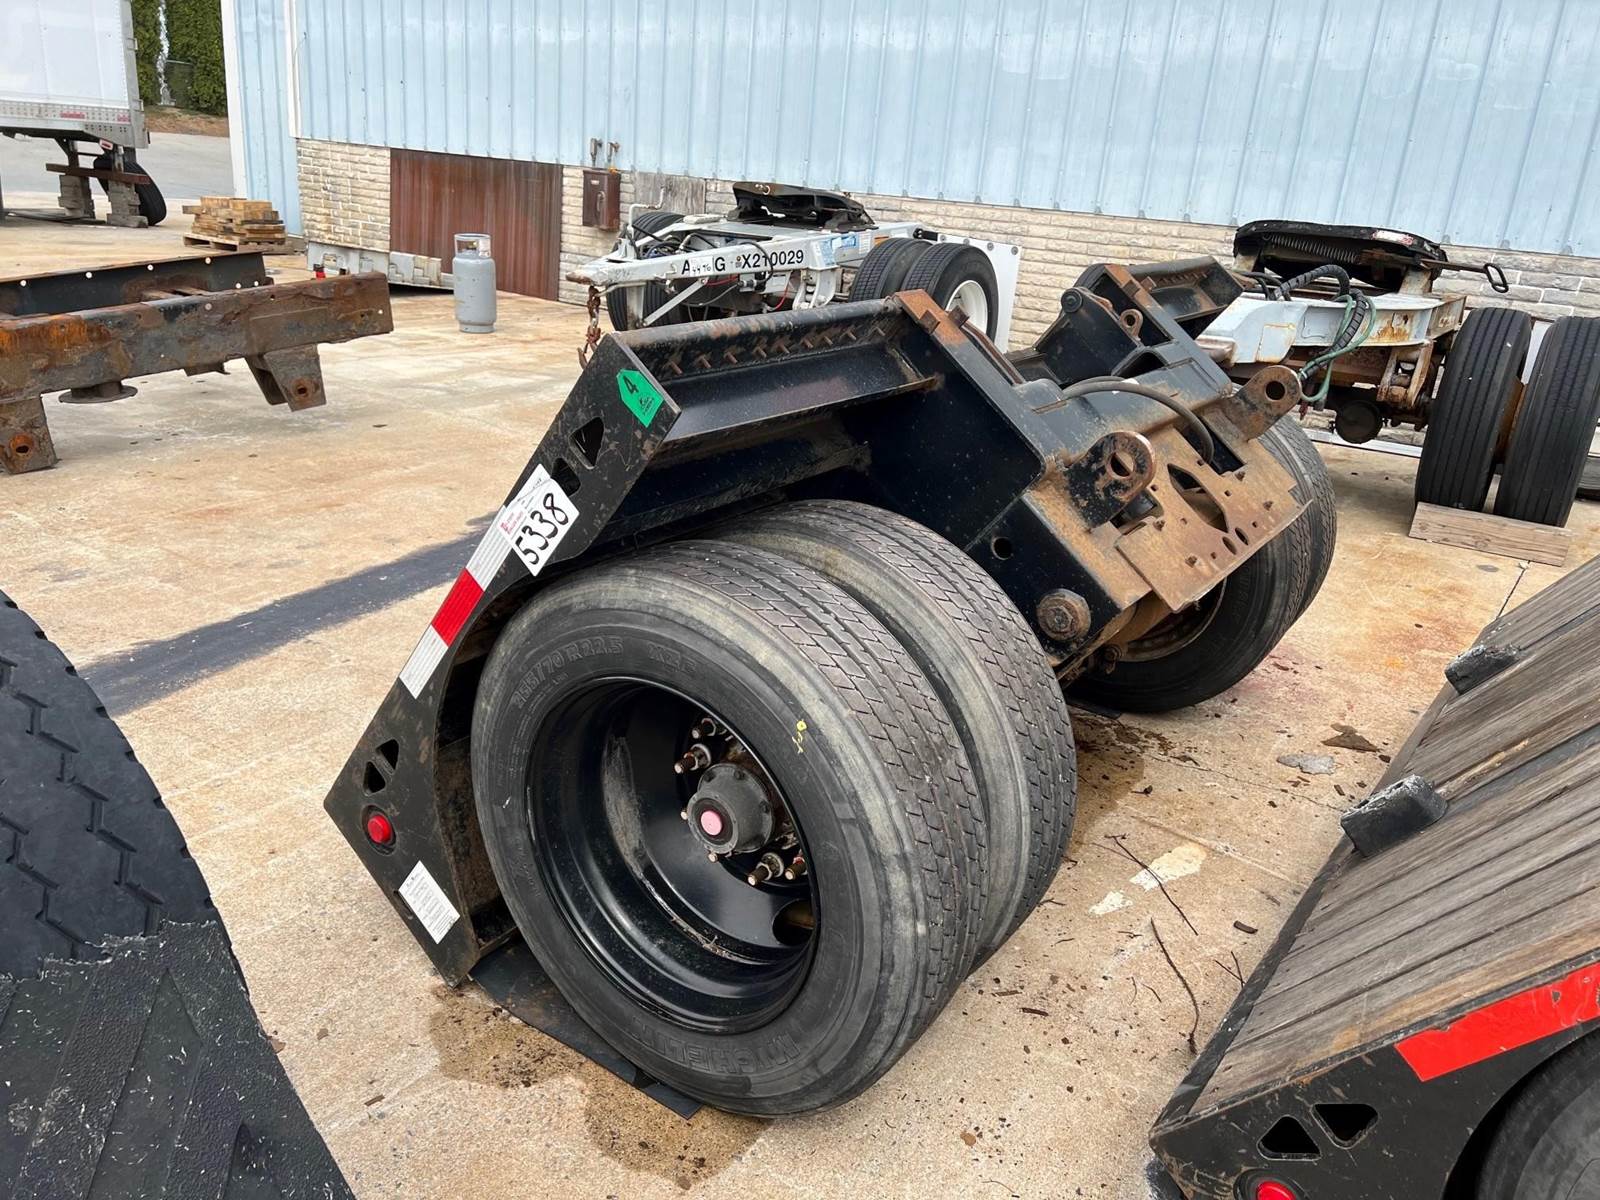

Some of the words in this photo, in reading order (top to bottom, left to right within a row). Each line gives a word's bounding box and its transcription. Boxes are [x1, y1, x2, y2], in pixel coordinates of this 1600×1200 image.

[741, 249, 804, 269] X210029
[622, 375, 639, 394] 4
[515, 492, 569, 565] 5338
